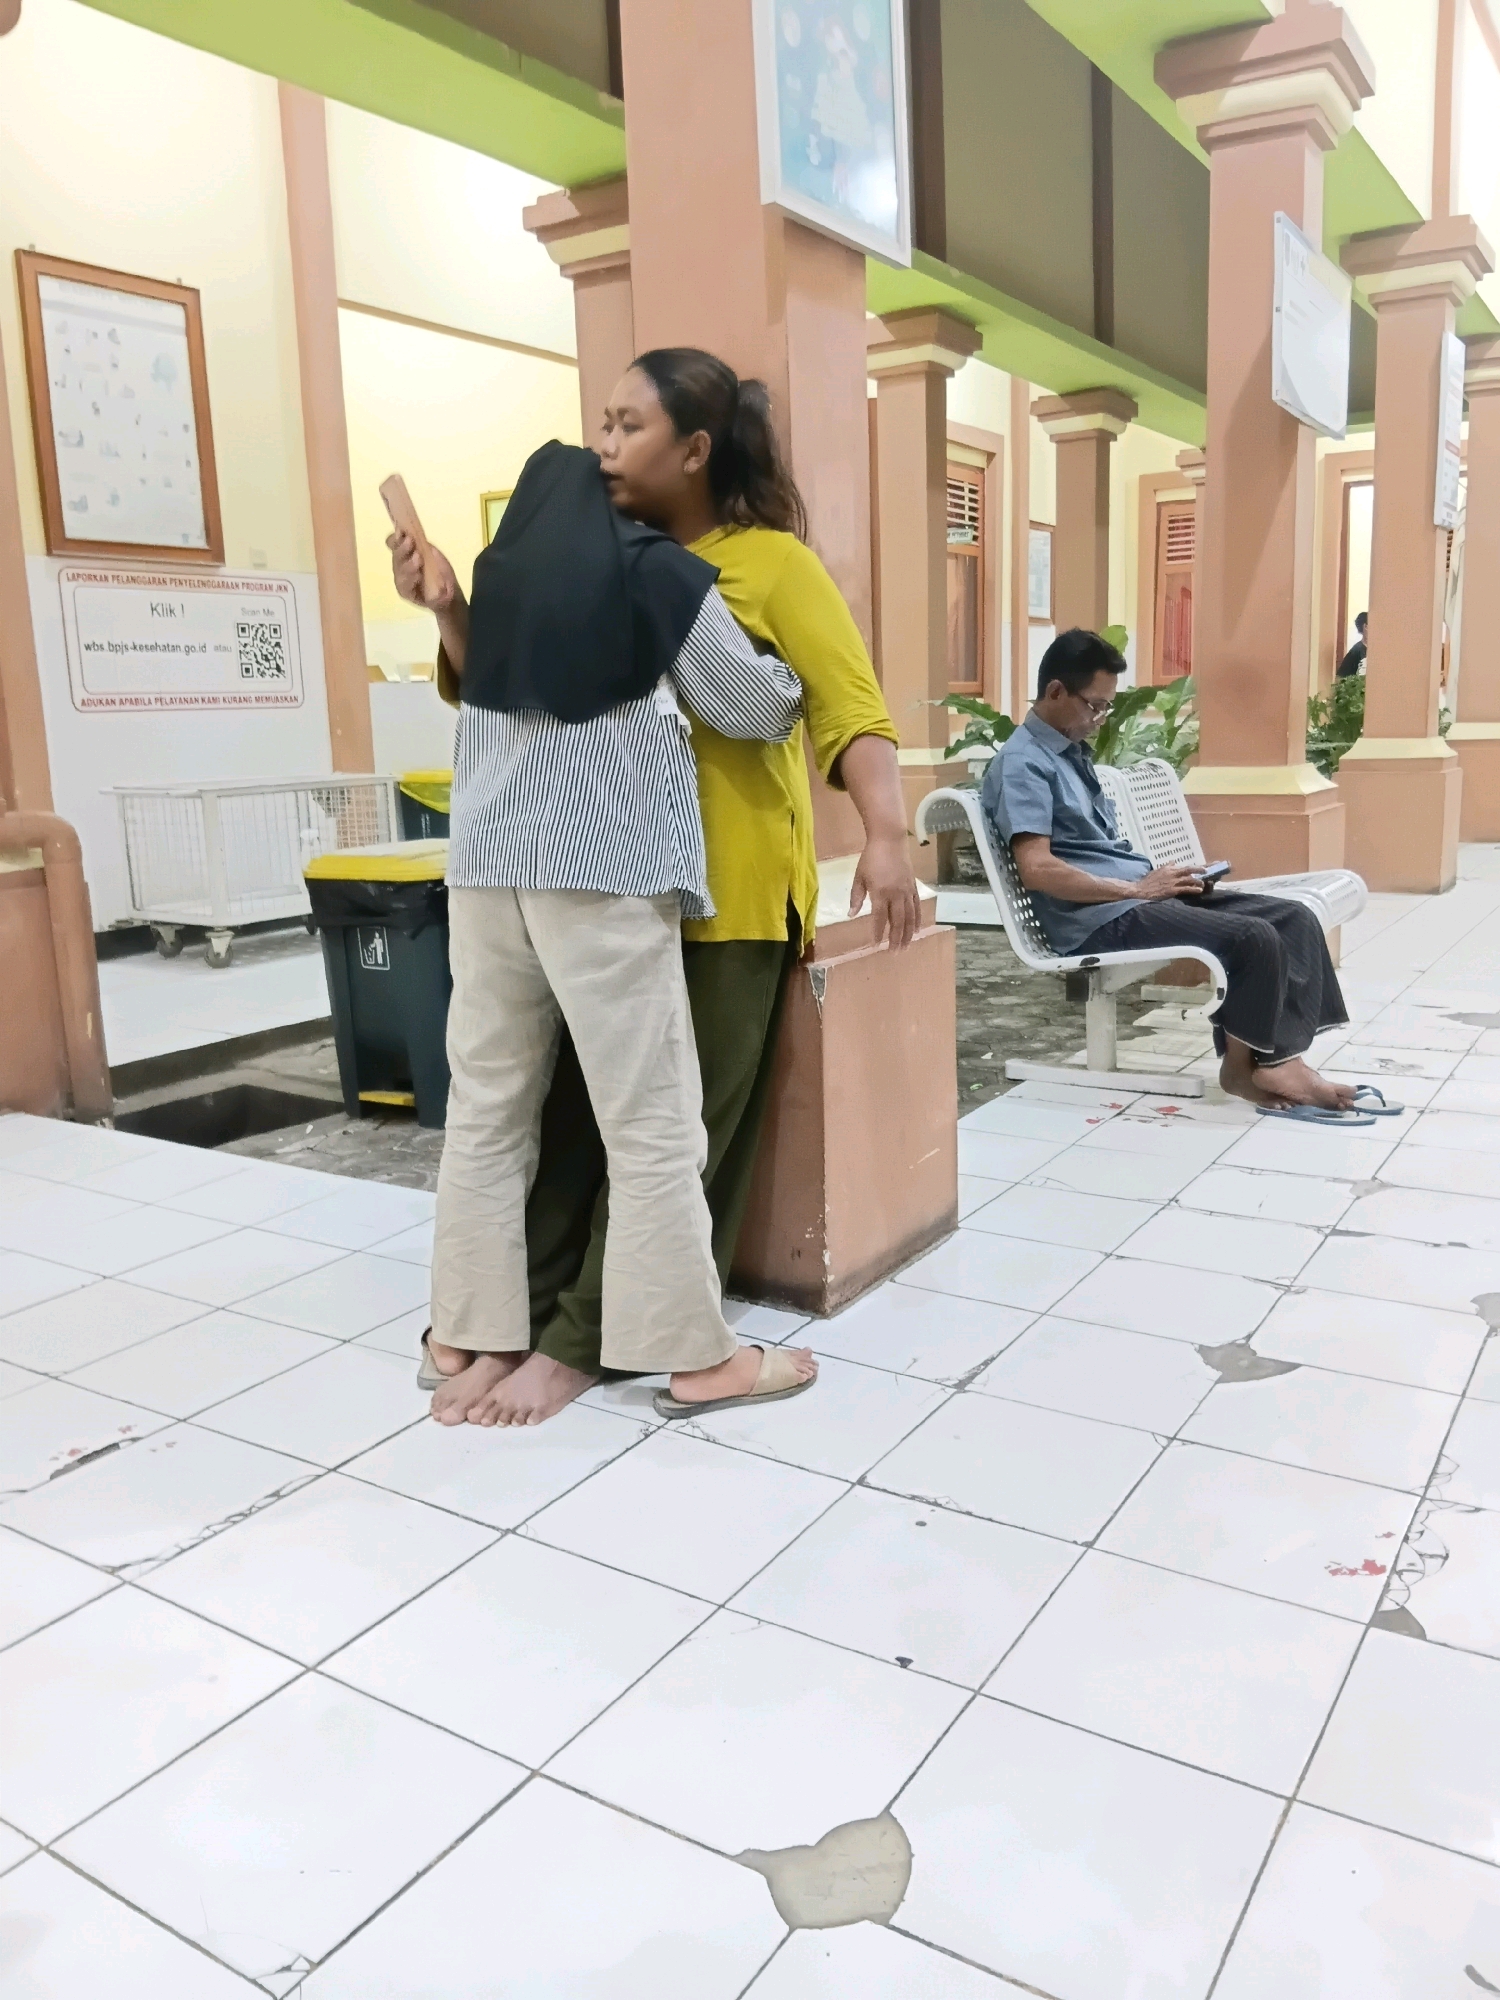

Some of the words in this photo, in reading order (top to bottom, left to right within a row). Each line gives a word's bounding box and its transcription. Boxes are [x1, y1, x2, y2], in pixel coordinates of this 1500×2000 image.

[66, 572, 109, 583] LAPORKAN
[111, 574, 168, 587] PELANGGARAN
[169, 577, 240, 591] PENYELENGGARAAN
[241, 581, 274, 592] PROGRAM
[275, 584, 289, 593] JKN
[150, 601, 177, 618] Klik
[241, 607, 260, 617] Scan
[262, 608, 275, 617] Me
[83, 640, 208, 656] wbs.bpjs-kesehatan.go.id
[213, 644, 233, 653] atau
[80, 697, 117, 708] ADUKAN
[118, 697, 153, 708] APABILA
[154, 696, 200, 707] PELAYANAN
[201, 696, 221, 706] KAMI
[222, 695, 253, 705] KURANG
[254, 694, 299, 704] MEMUASKAN
